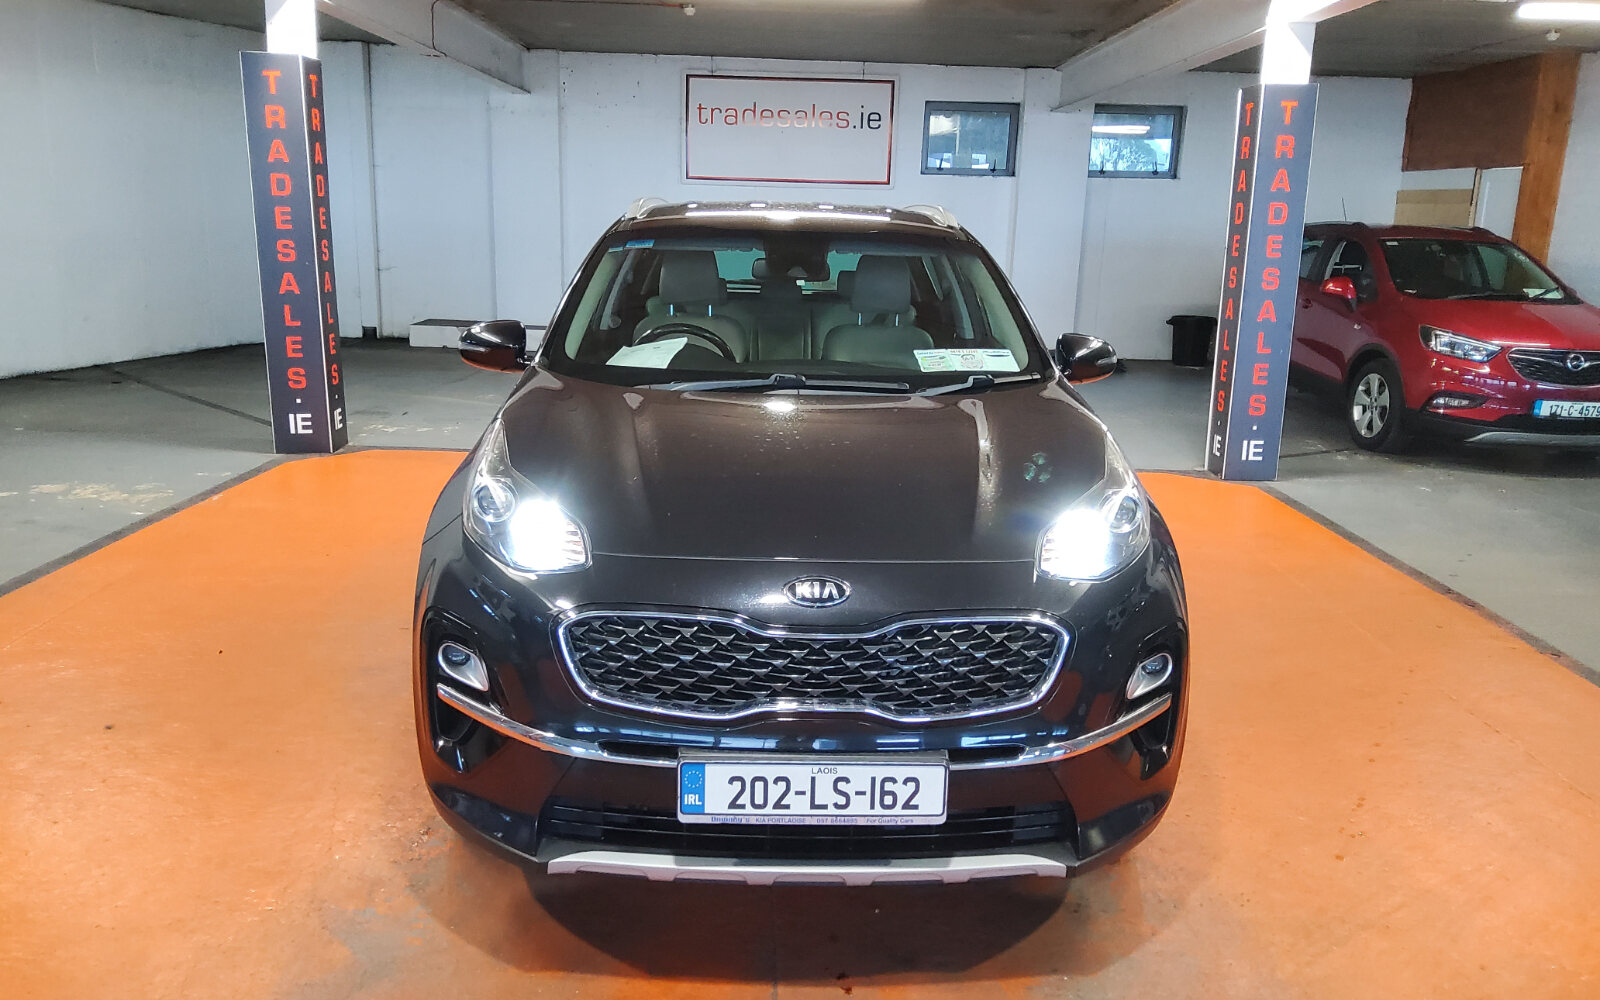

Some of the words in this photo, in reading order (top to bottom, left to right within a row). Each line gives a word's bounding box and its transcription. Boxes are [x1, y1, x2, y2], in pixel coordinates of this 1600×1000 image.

[697, 101, 882, 129] tradesales.ie
[795, 581, 840, 599] KIA
[811, 767, 839, 775] LAOIS
[684, 794, 703, 805] IRL
[727, 775, 921, 811] 202-LS-162
